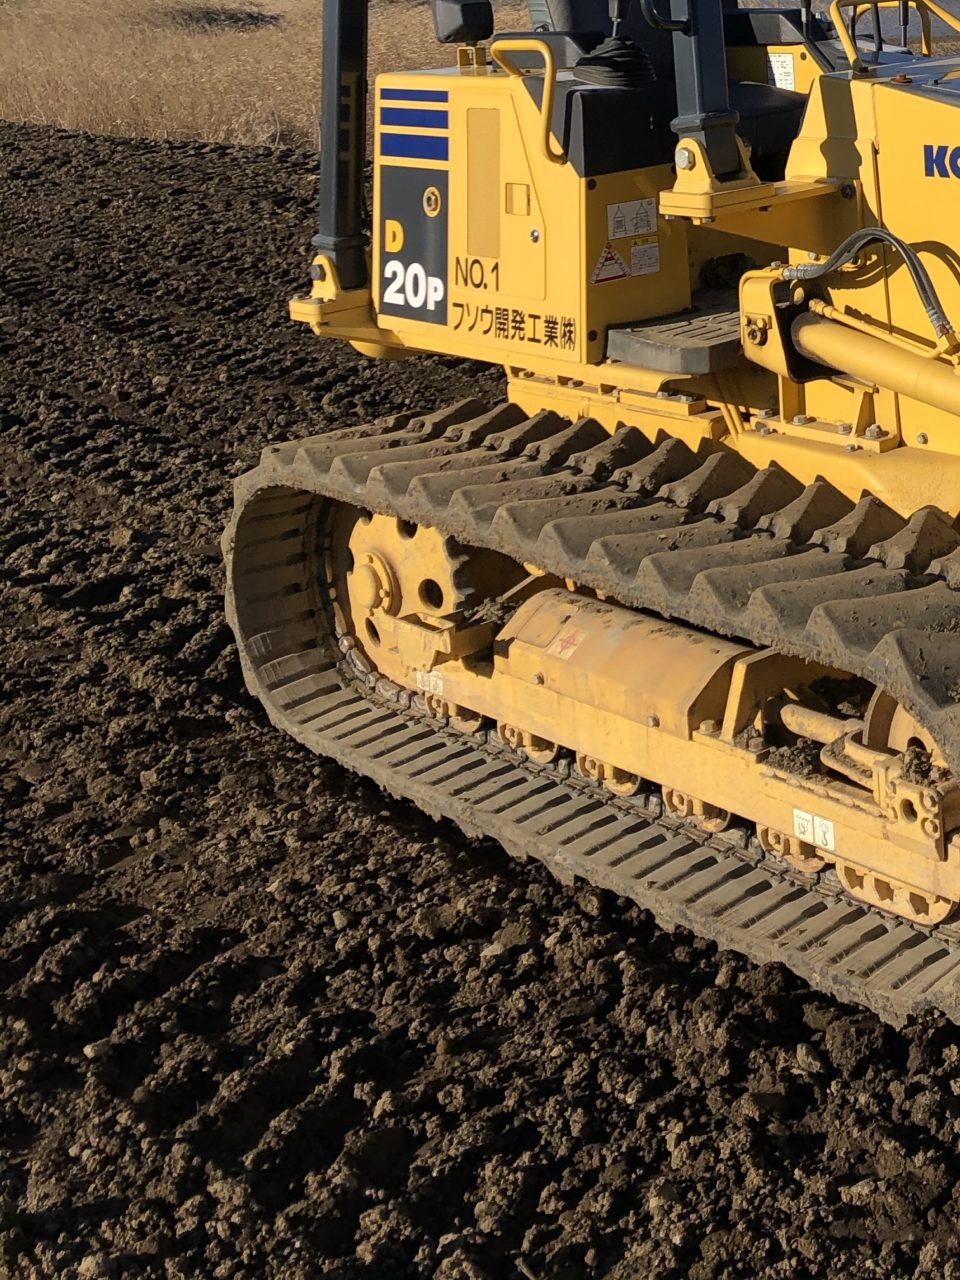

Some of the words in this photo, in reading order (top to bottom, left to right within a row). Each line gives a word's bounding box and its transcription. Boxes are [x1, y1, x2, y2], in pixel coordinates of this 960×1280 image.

[384, 219, 404, 253] D
[382, 259, 445, 311] 20P
[455, 256, 499, 292] NO.1
